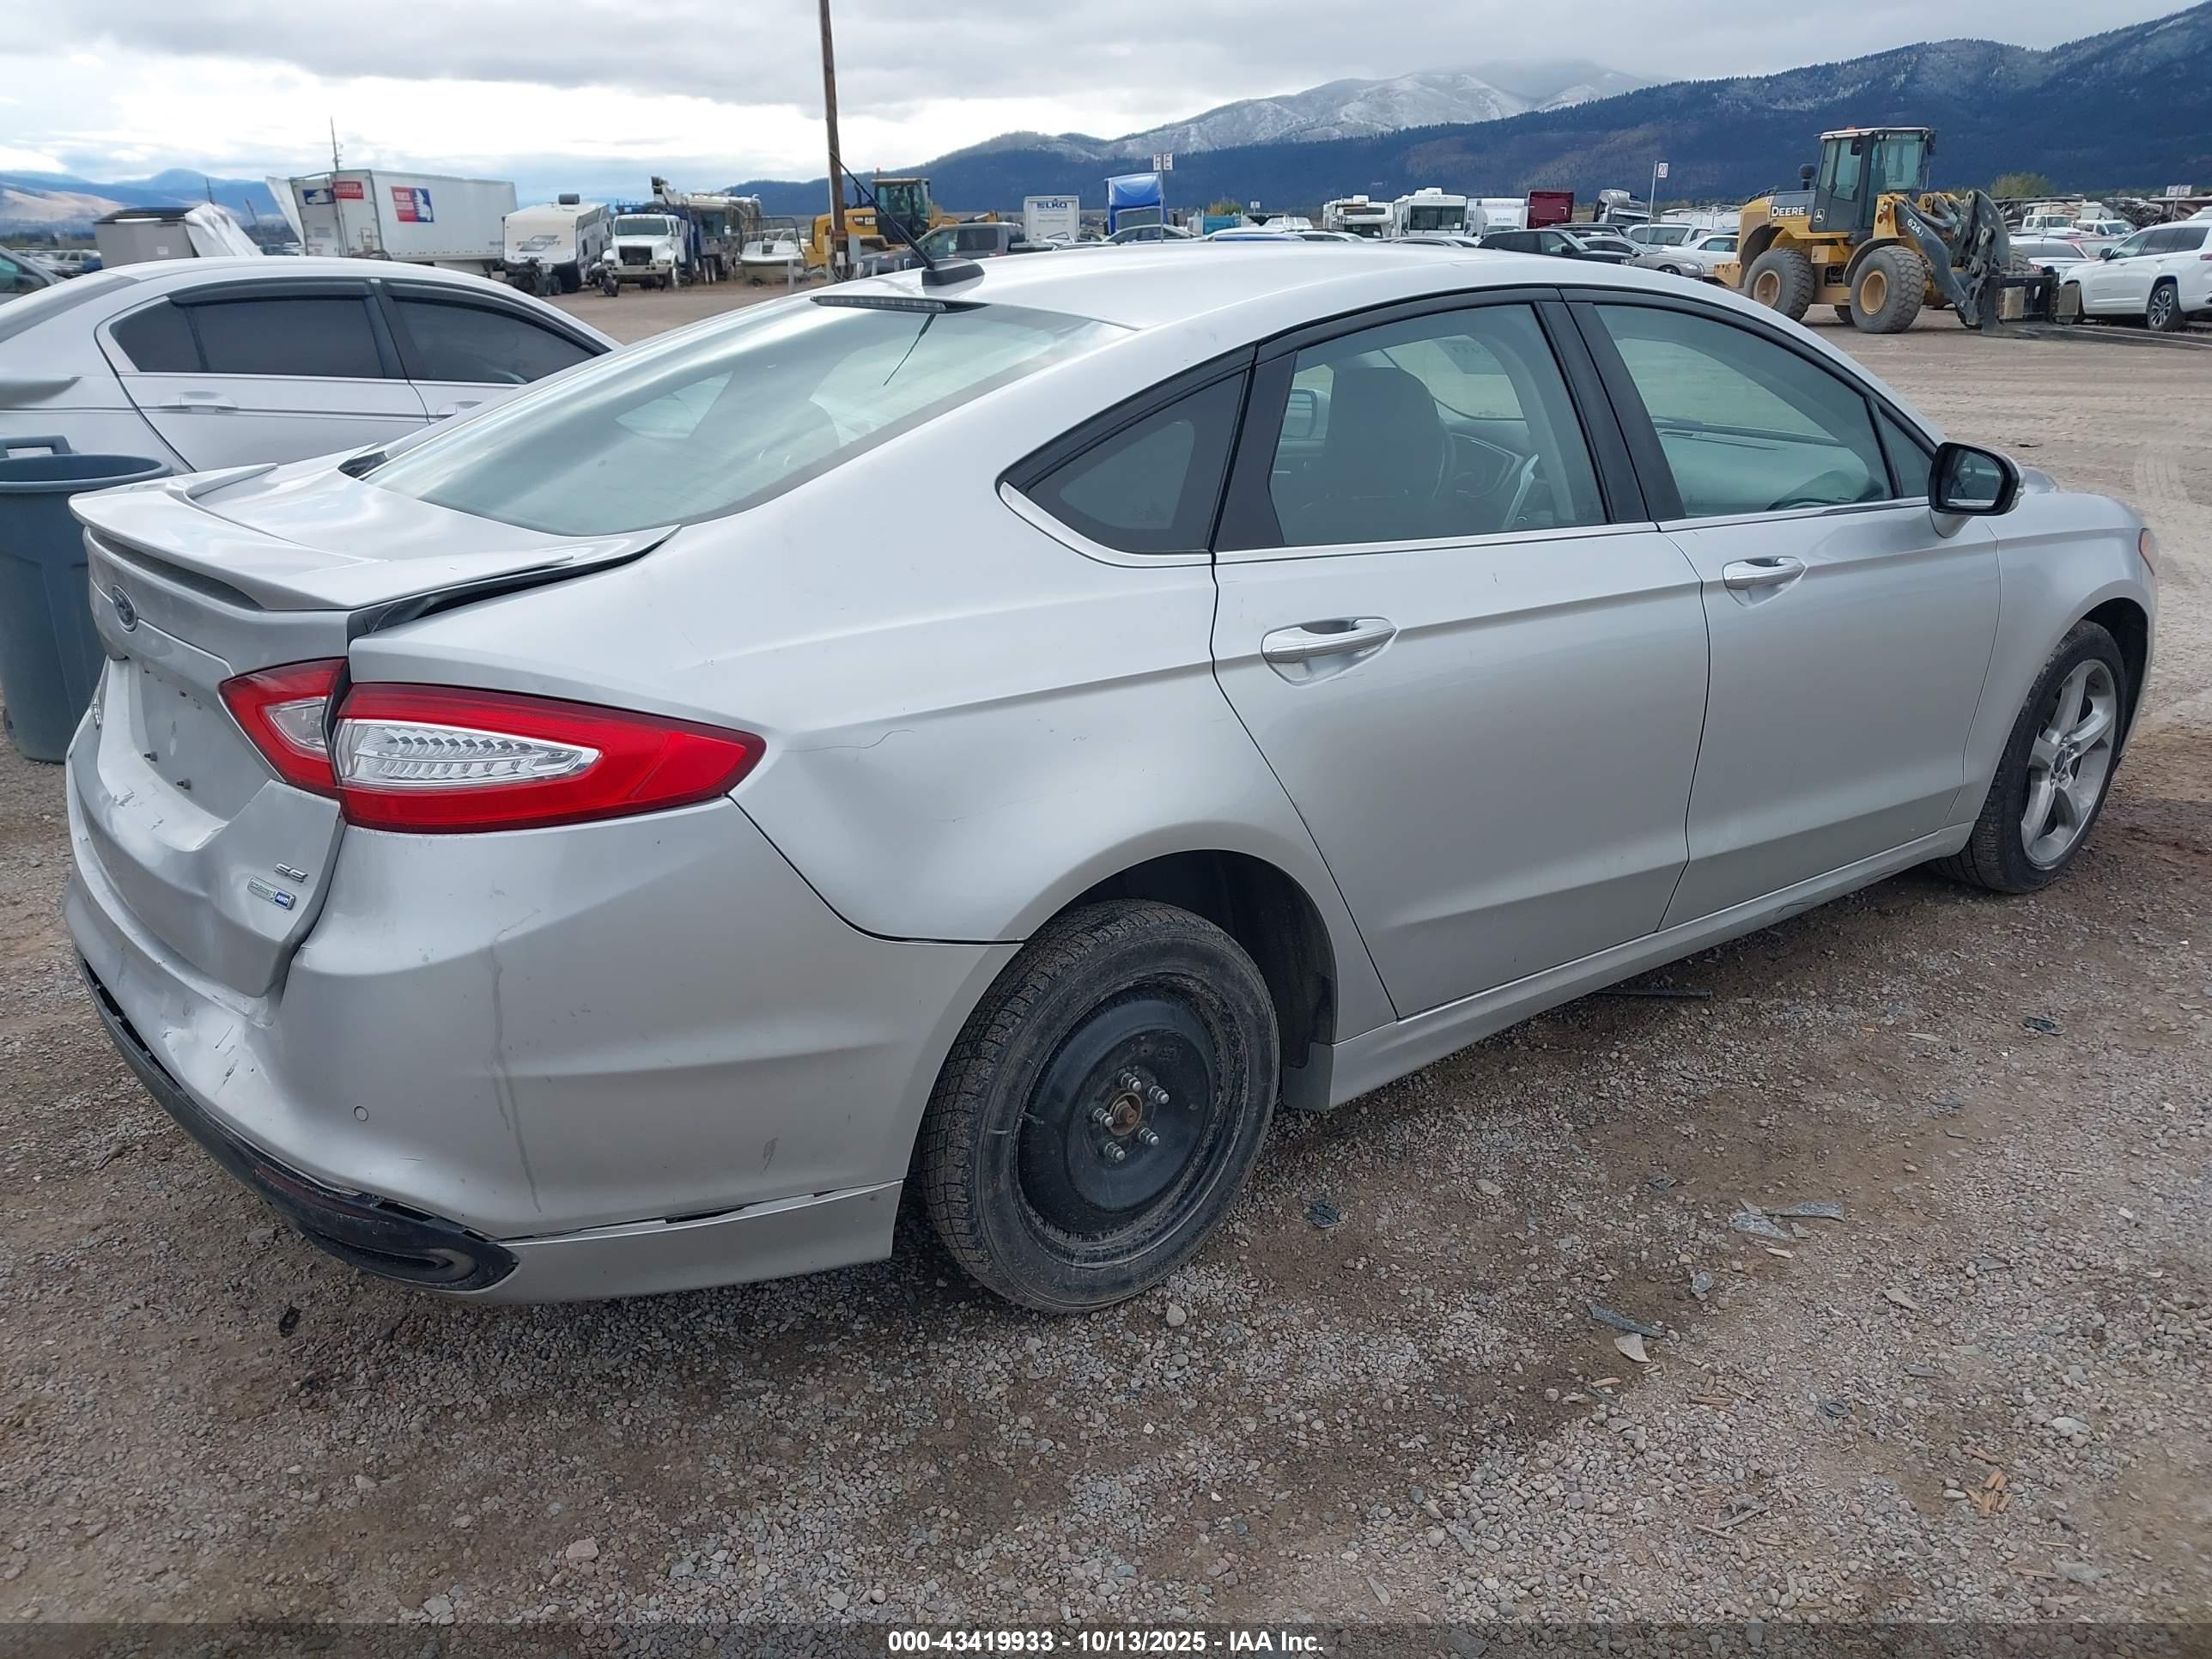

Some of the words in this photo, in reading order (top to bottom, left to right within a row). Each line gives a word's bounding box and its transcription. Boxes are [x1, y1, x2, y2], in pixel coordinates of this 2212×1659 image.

[1659, 164, 1668, 176] 20
[1771, 206, 1806, 216] DEERE
[274, 862, 308, 883] SE
